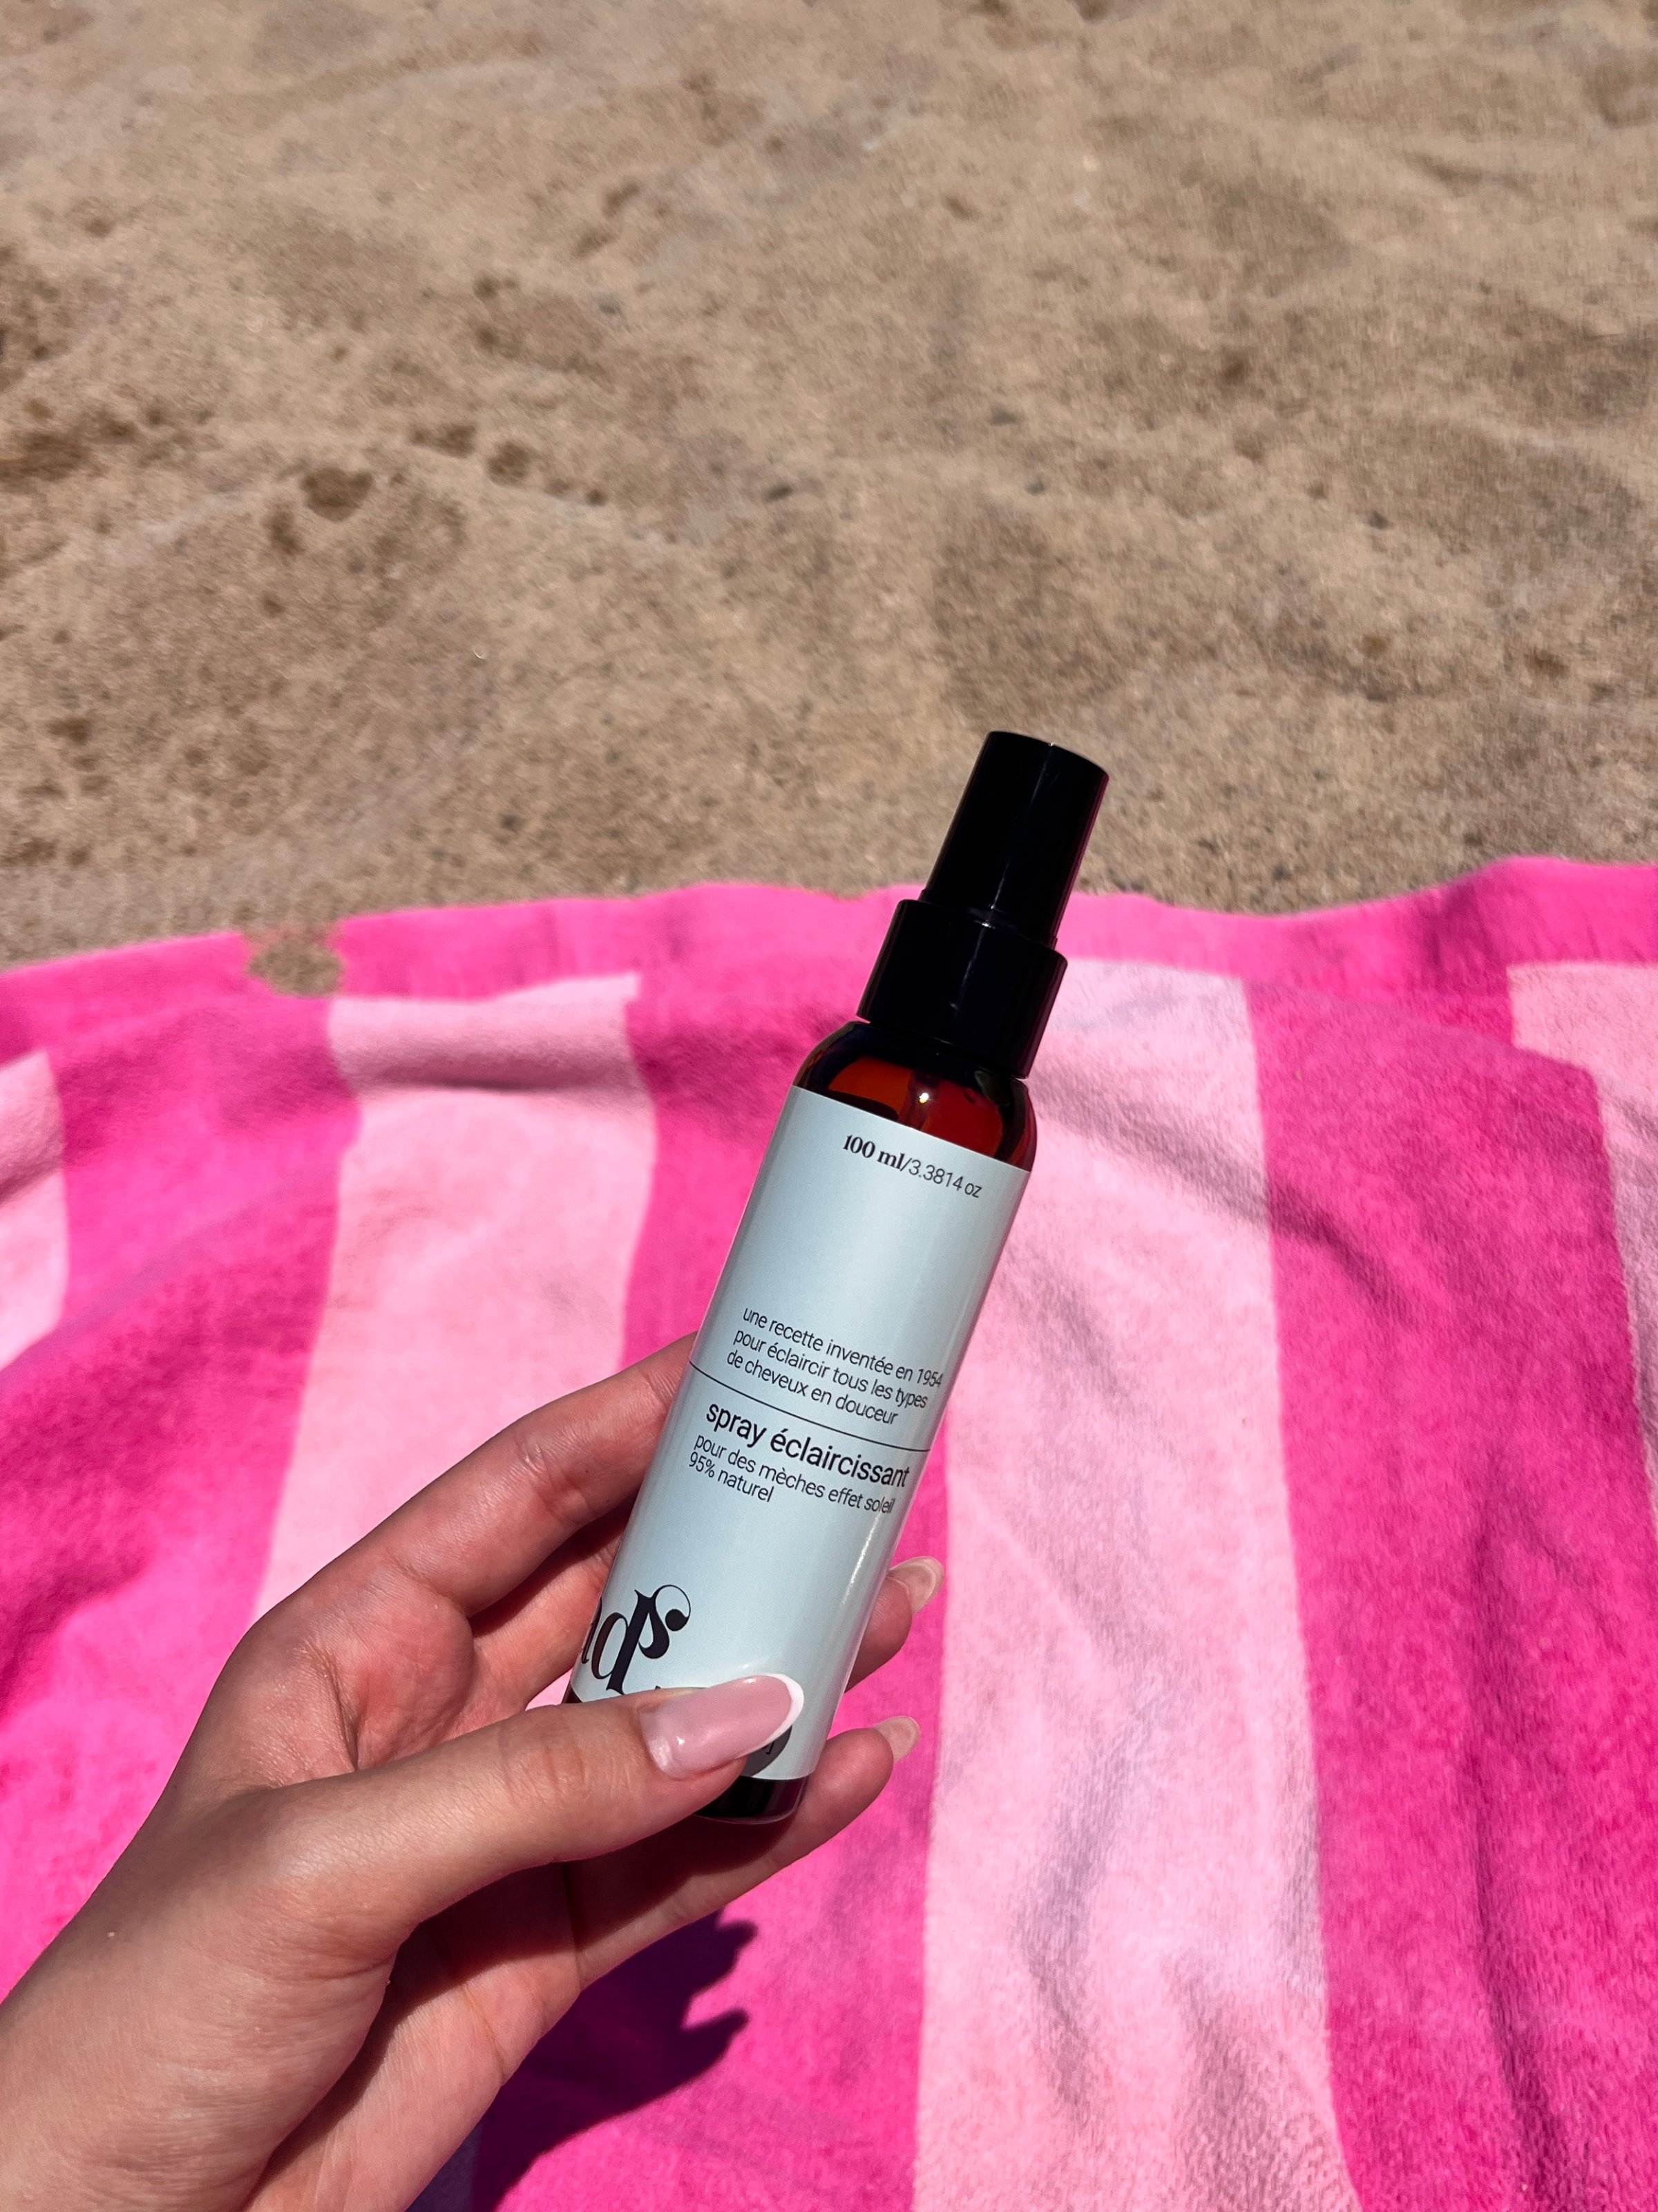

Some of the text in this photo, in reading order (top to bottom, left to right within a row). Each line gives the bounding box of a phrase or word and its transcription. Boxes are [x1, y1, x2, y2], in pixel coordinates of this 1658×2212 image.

[842, 1134, 982, 1198] 100 ml/3.3814 oz
[726, 1350, 898, 1425] de cheveux en douceur
[733, 1329, 928, 1409] pour éclaircir tous les types
[743, 1307, 943, 1388] une recette inventée en 1954
[689, 1452, 774, 1502] 95% naturel
[694, 1434, 895, 1514] pour des mèches effet soleil
[706, 1403, 911, 1487] spray éclaircissant
